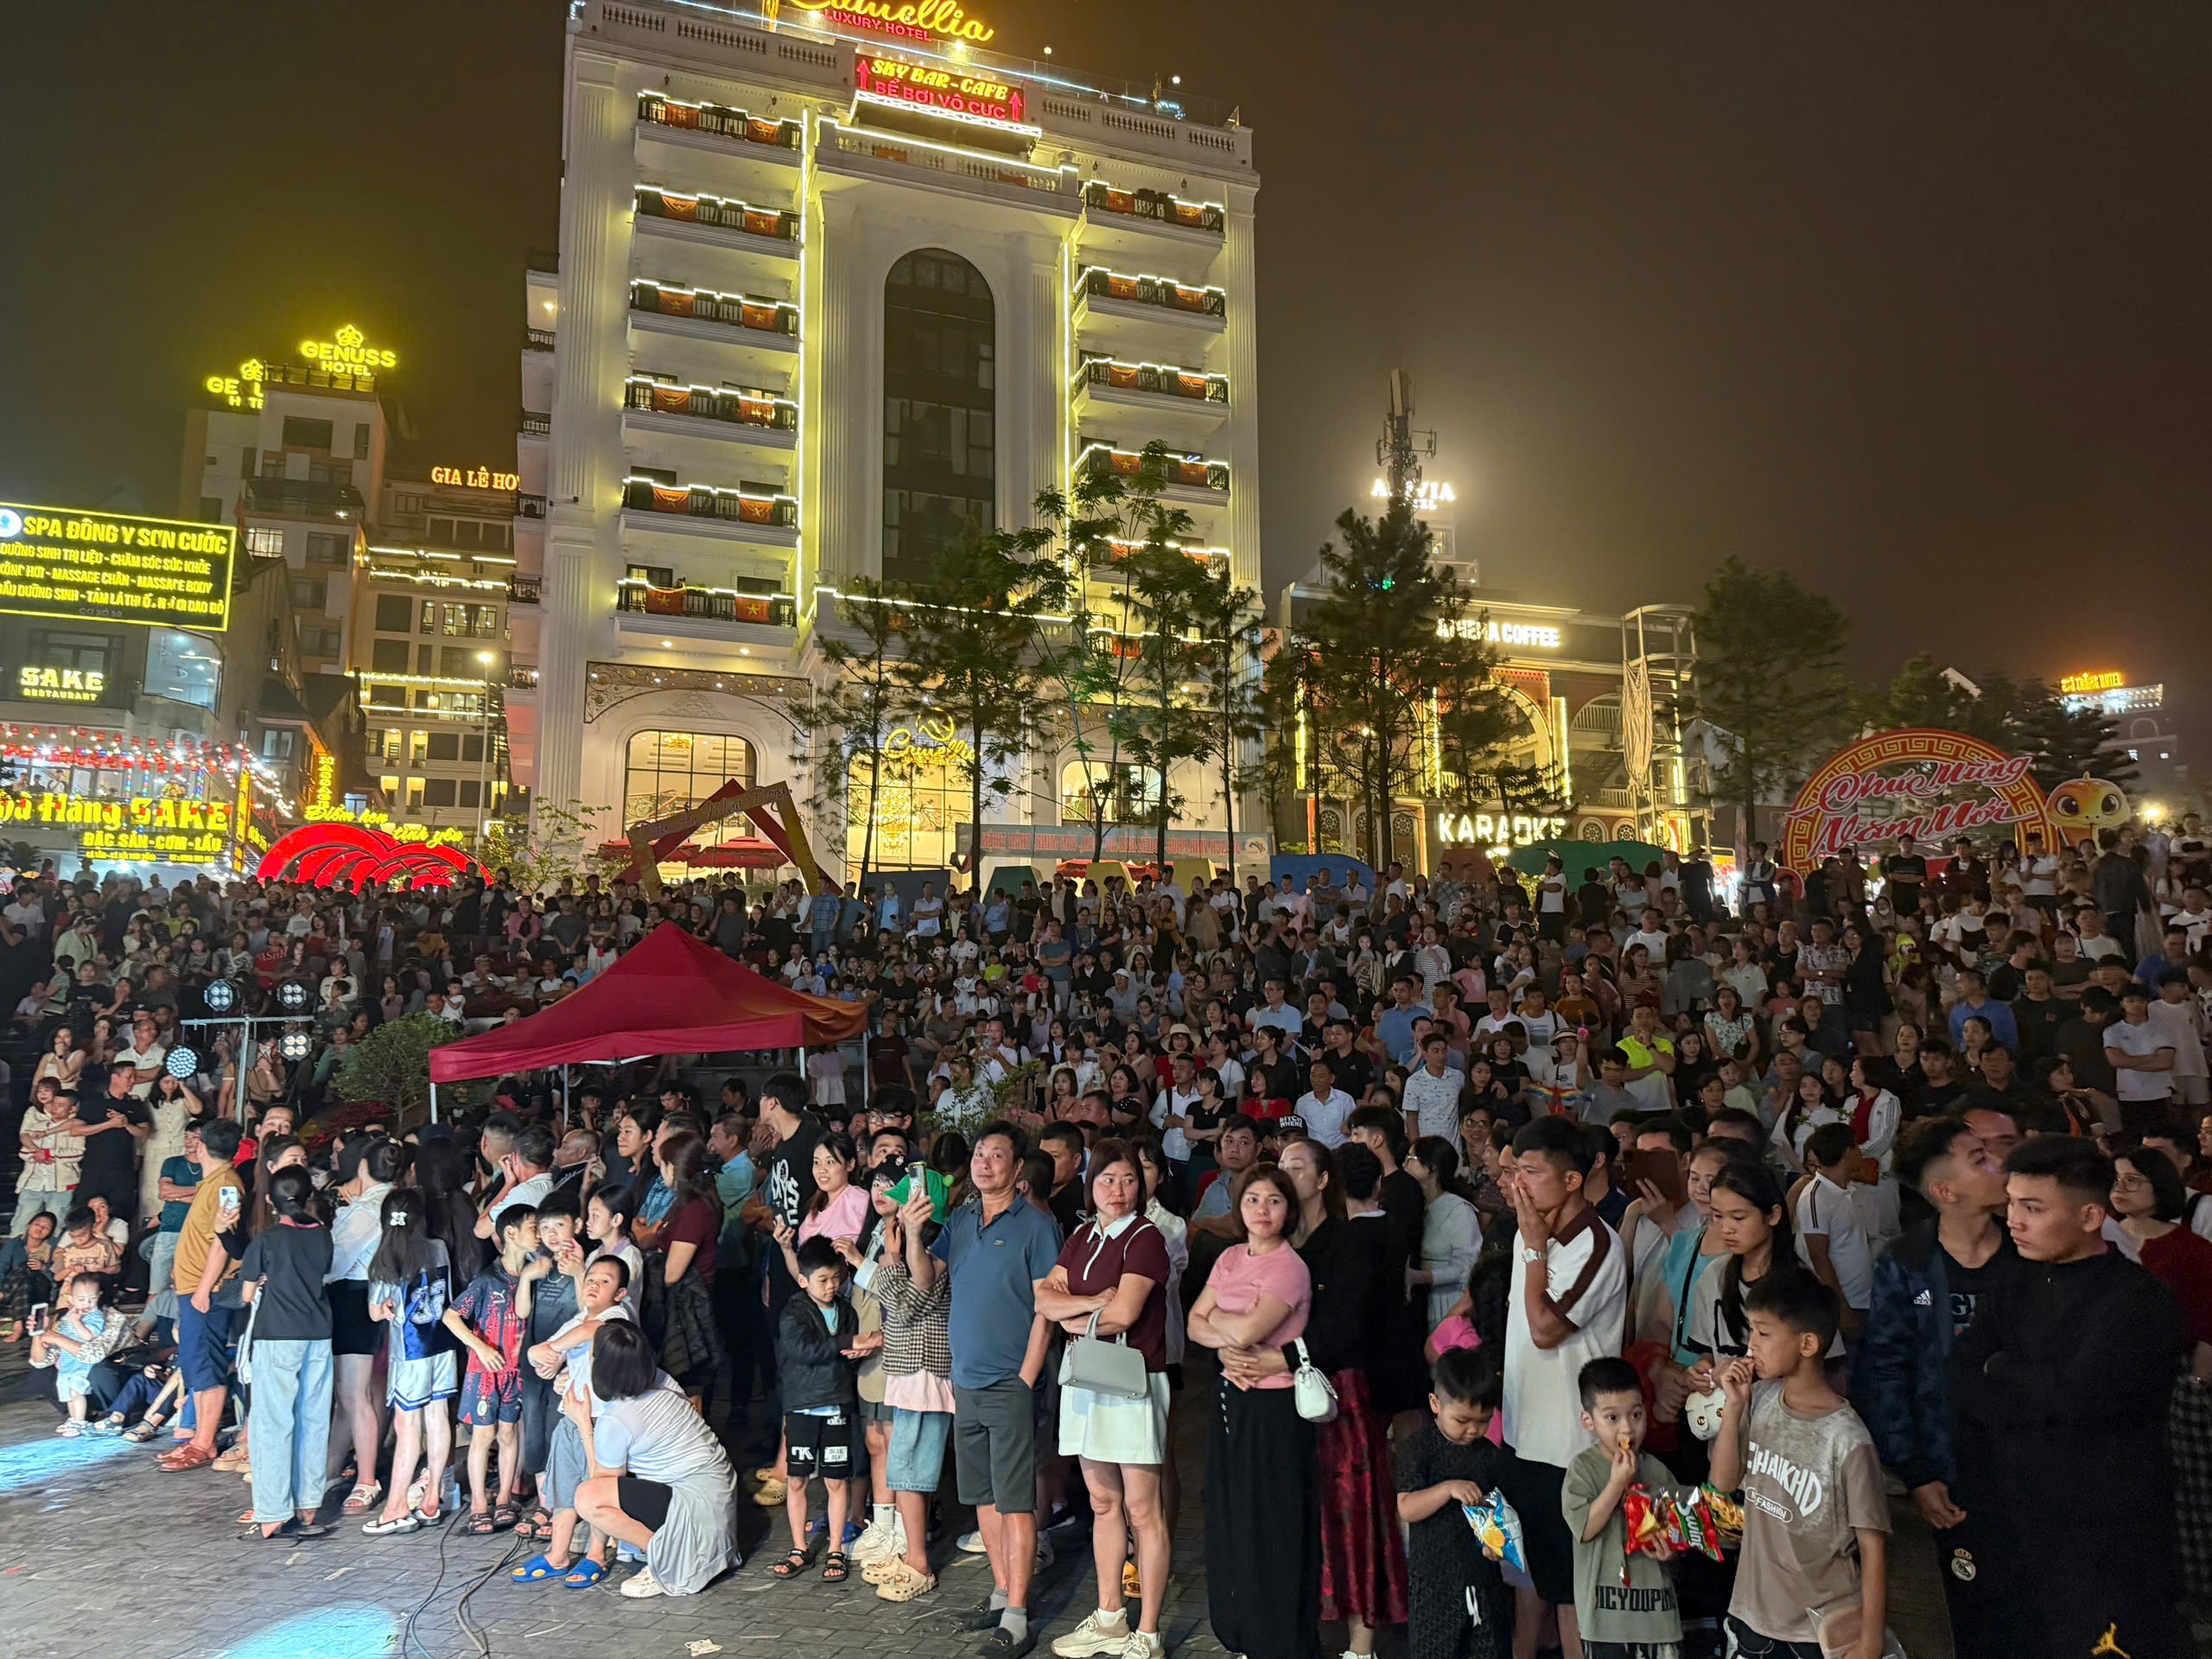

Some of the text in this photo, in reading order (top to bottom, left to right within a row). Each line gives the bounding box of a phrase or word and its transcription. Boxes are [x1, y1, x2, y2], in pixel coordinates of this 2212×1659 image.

[823, 9, 933, 41] LUXURY HOTEL
[871, 60, 910, 79] SKY
[938, 93, 964, 111] VÔ
[301, 340, 397, 367] GENUSS
[321, 360, 372, 377] HOTEL
[431, 467, 462, 486] GIA
[467, 466, 489, 488] LÊ
[23, 517, 63, 538] SPA
[66, 518, 118, 543] ĐÔNG
[121, 525, 136, 545] Y
[137, 528, 176, 550] SƠN
[36, 546, 61, 561] SINH
[80, 549, 103, 565] LIỆU
[142, 555, 162, 569] SÓC
[51, 567, 101, 583] MASSAGE
[101, 571, 130, 587] CHÂN
[186, 580, 213, 594] BODY
[54, 588, 79, 601] SINH
[188, 600, 208, 613] DAO
[1502, 623, 1560, 647] COFFEE
[21, 667, 104, 691] SAKE
[23, 688, 98, 701] RESTAURANT
[1784, 755, 2032, 819] Chúc Mừng
[37, 792, 122, 830] Hàng
[130, 798, 229, 830] SAKE
[1439, 813, 1566, 845] KARAOKE
[1807, 796, 2039, 859] Năm Mới
